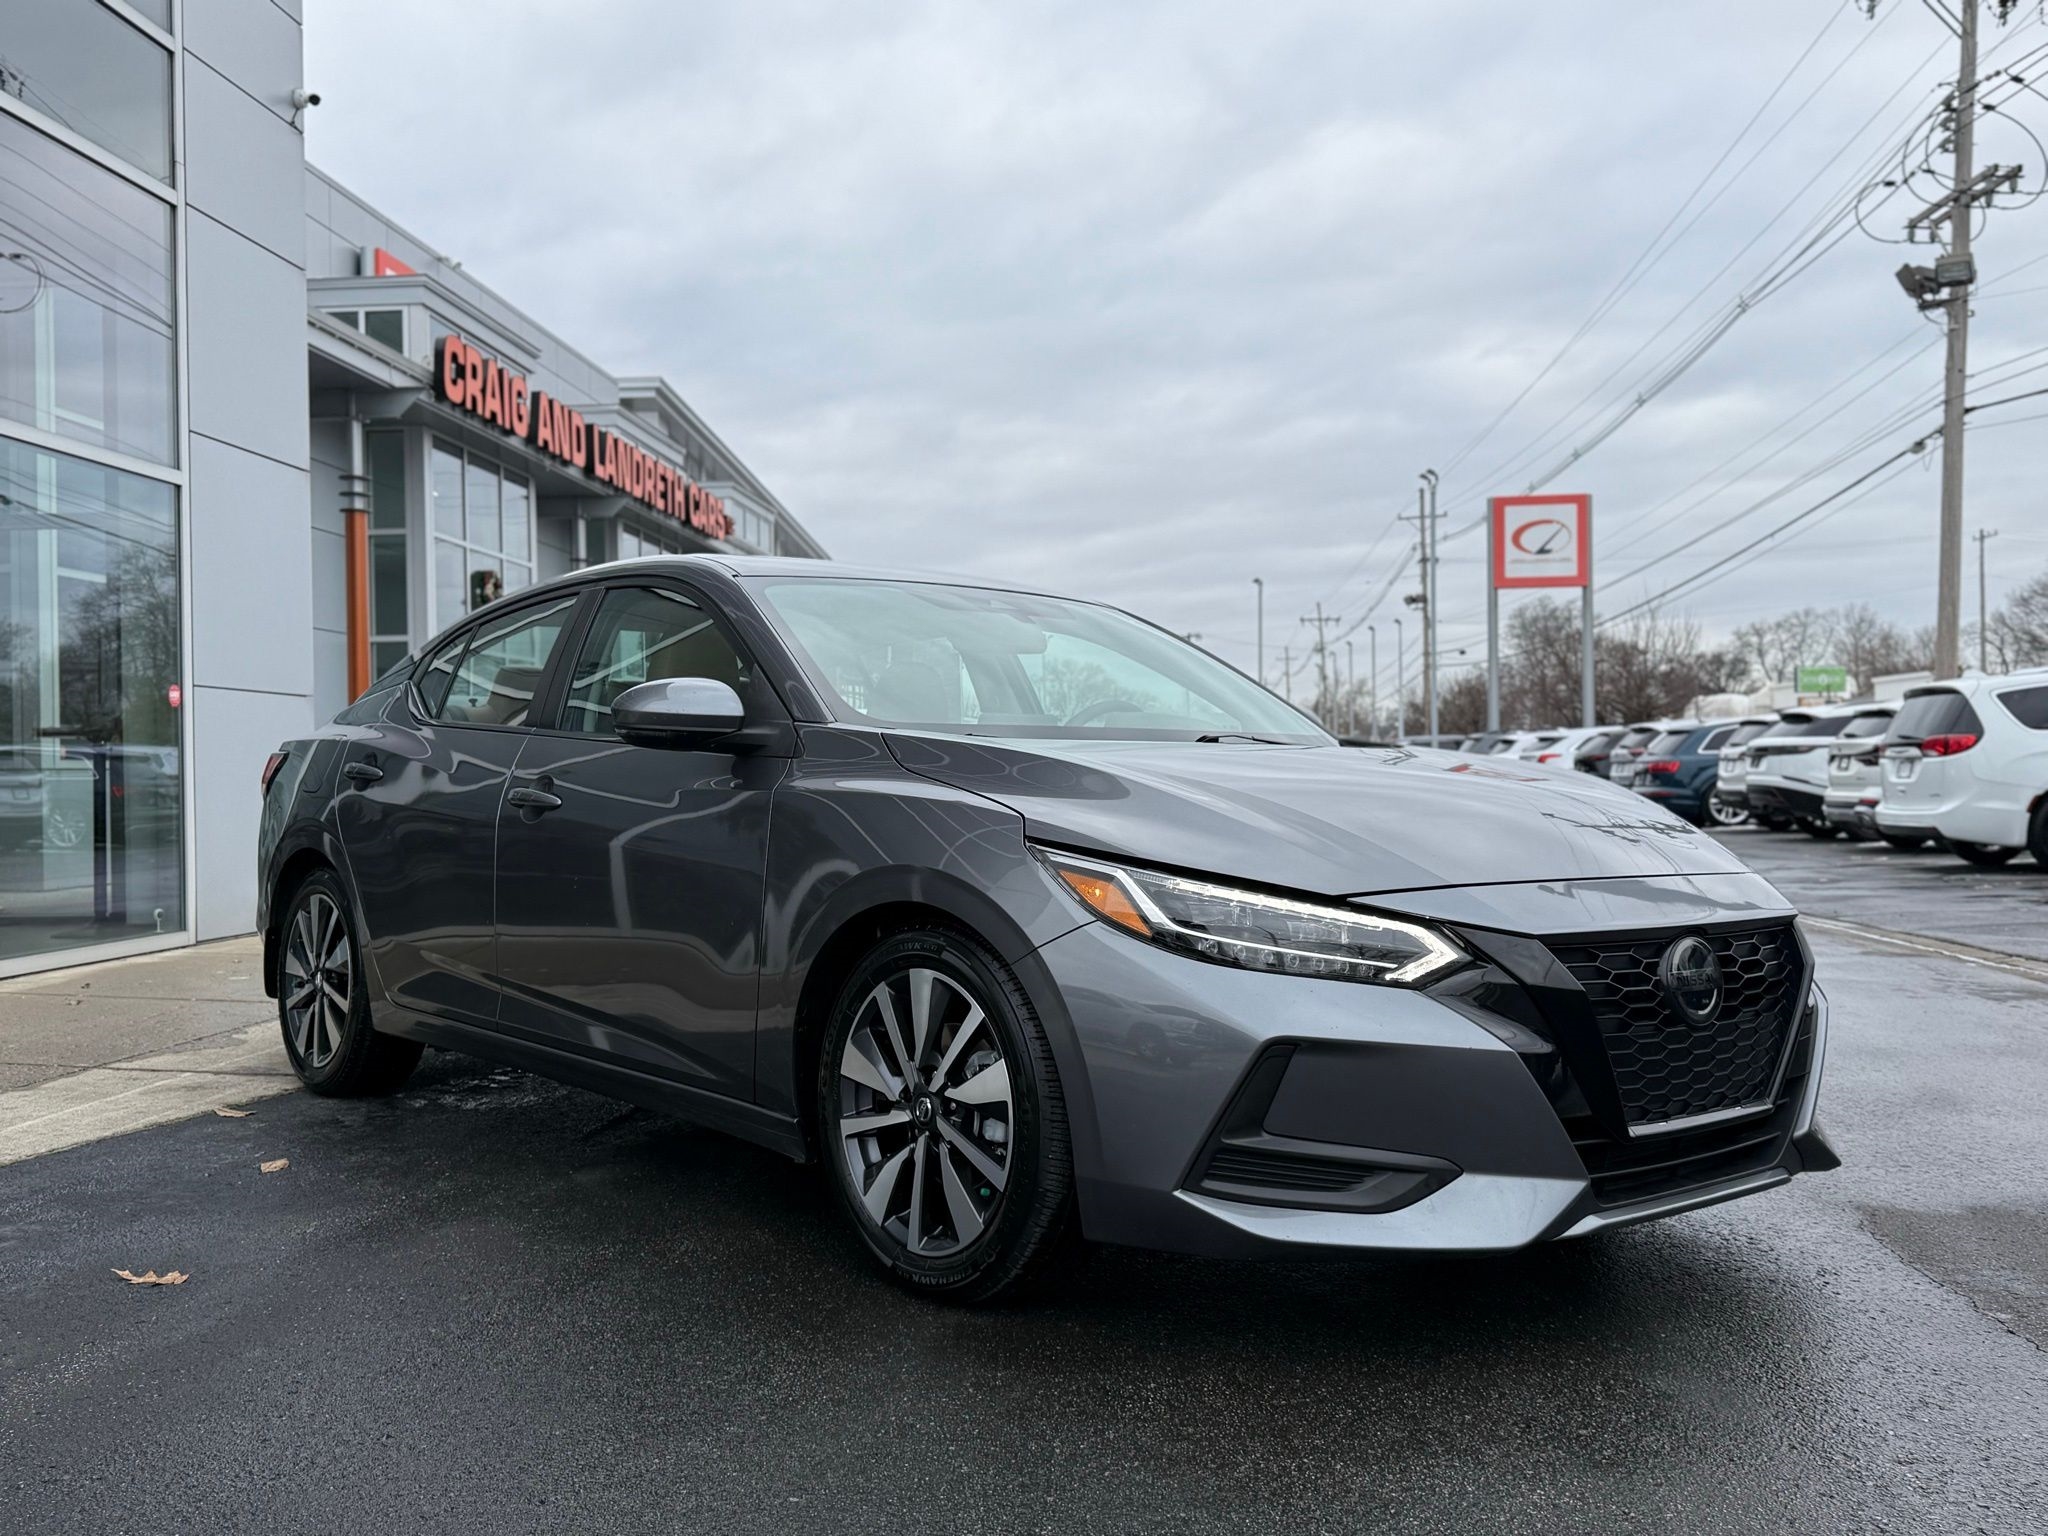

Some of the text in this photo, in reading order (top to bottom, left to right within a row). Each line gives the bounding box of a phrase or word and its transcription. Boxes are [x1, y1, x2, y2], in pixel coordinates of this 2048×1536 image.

[443, 334, 727, 541] CRAIG AND LANDRETH CARS
